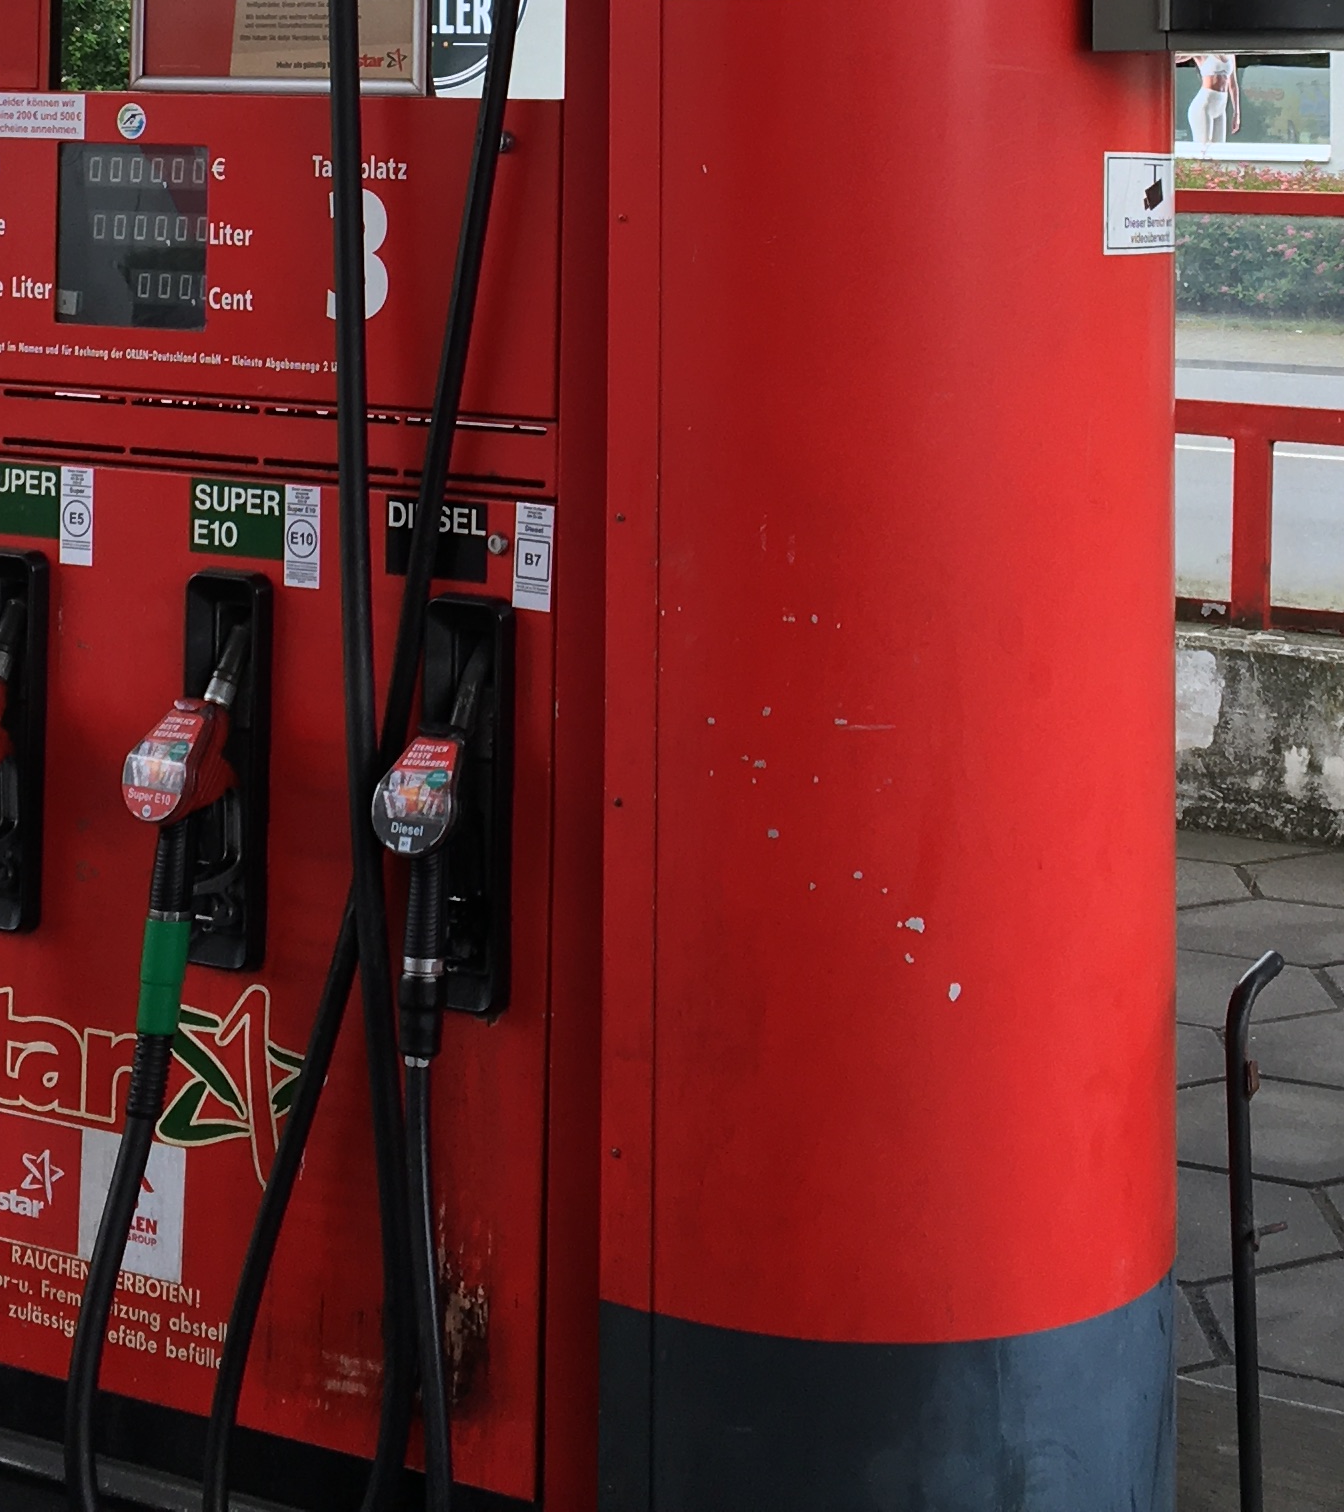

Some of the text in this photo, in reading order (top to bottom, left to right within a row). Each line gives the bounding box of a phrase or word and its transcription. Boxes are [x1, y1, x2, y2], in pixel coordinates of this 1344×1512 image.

[26, 97, 59, 107] können
[61, 98, 76, 107] wir
[40, 111, 57, 120] und
[30, 125, 79, 134] annehmen.
[211, 157, 226, 180] €
[312, 154, 408, 182] Taplatz
[208, 222, 253, 247] Liter
[11, 276, 52, 300] Liter
[208, 287, 253, 311] Cent
[7, 340, 16, 352] im
[18, 342, 43, 355] Namen
[46, 343, 59, 356] und
[61, 344, 72, 356] für
[74, 345, 108, 361] Rechnung
[110, 347, 123, 359] der
[199, 352, 221, 365] GmbH
[232, 354, 263, 368] Kleinste
[265, 356, 320, 374] Abgabemenge
[323, 360, 329, 372] 2
[69, 487, 85, 497] Super
[194, 485, 281, 516] SUPER
[69, 512, 85, 526] E5
[287, 504, 306, 516] Super
[388, 501, 487, 537] DISEL
[194, 520, 238, 548] E10
[290, 531, 314, 547] E10
[524, 524, 544, 535] Diesel
[524, 552, 542, 568] B7
[128, 787, 171, 806] Super E10
[391, 821, 424, 838] Diesel
[11, 1245, 201, 1308] RAUCHEN ERBOTEN!
[42, 1279, 161, 1332] Fremizung
[169, 1313, 228, 1343] abstell
[108, 1325, 157, 1355] efäße
